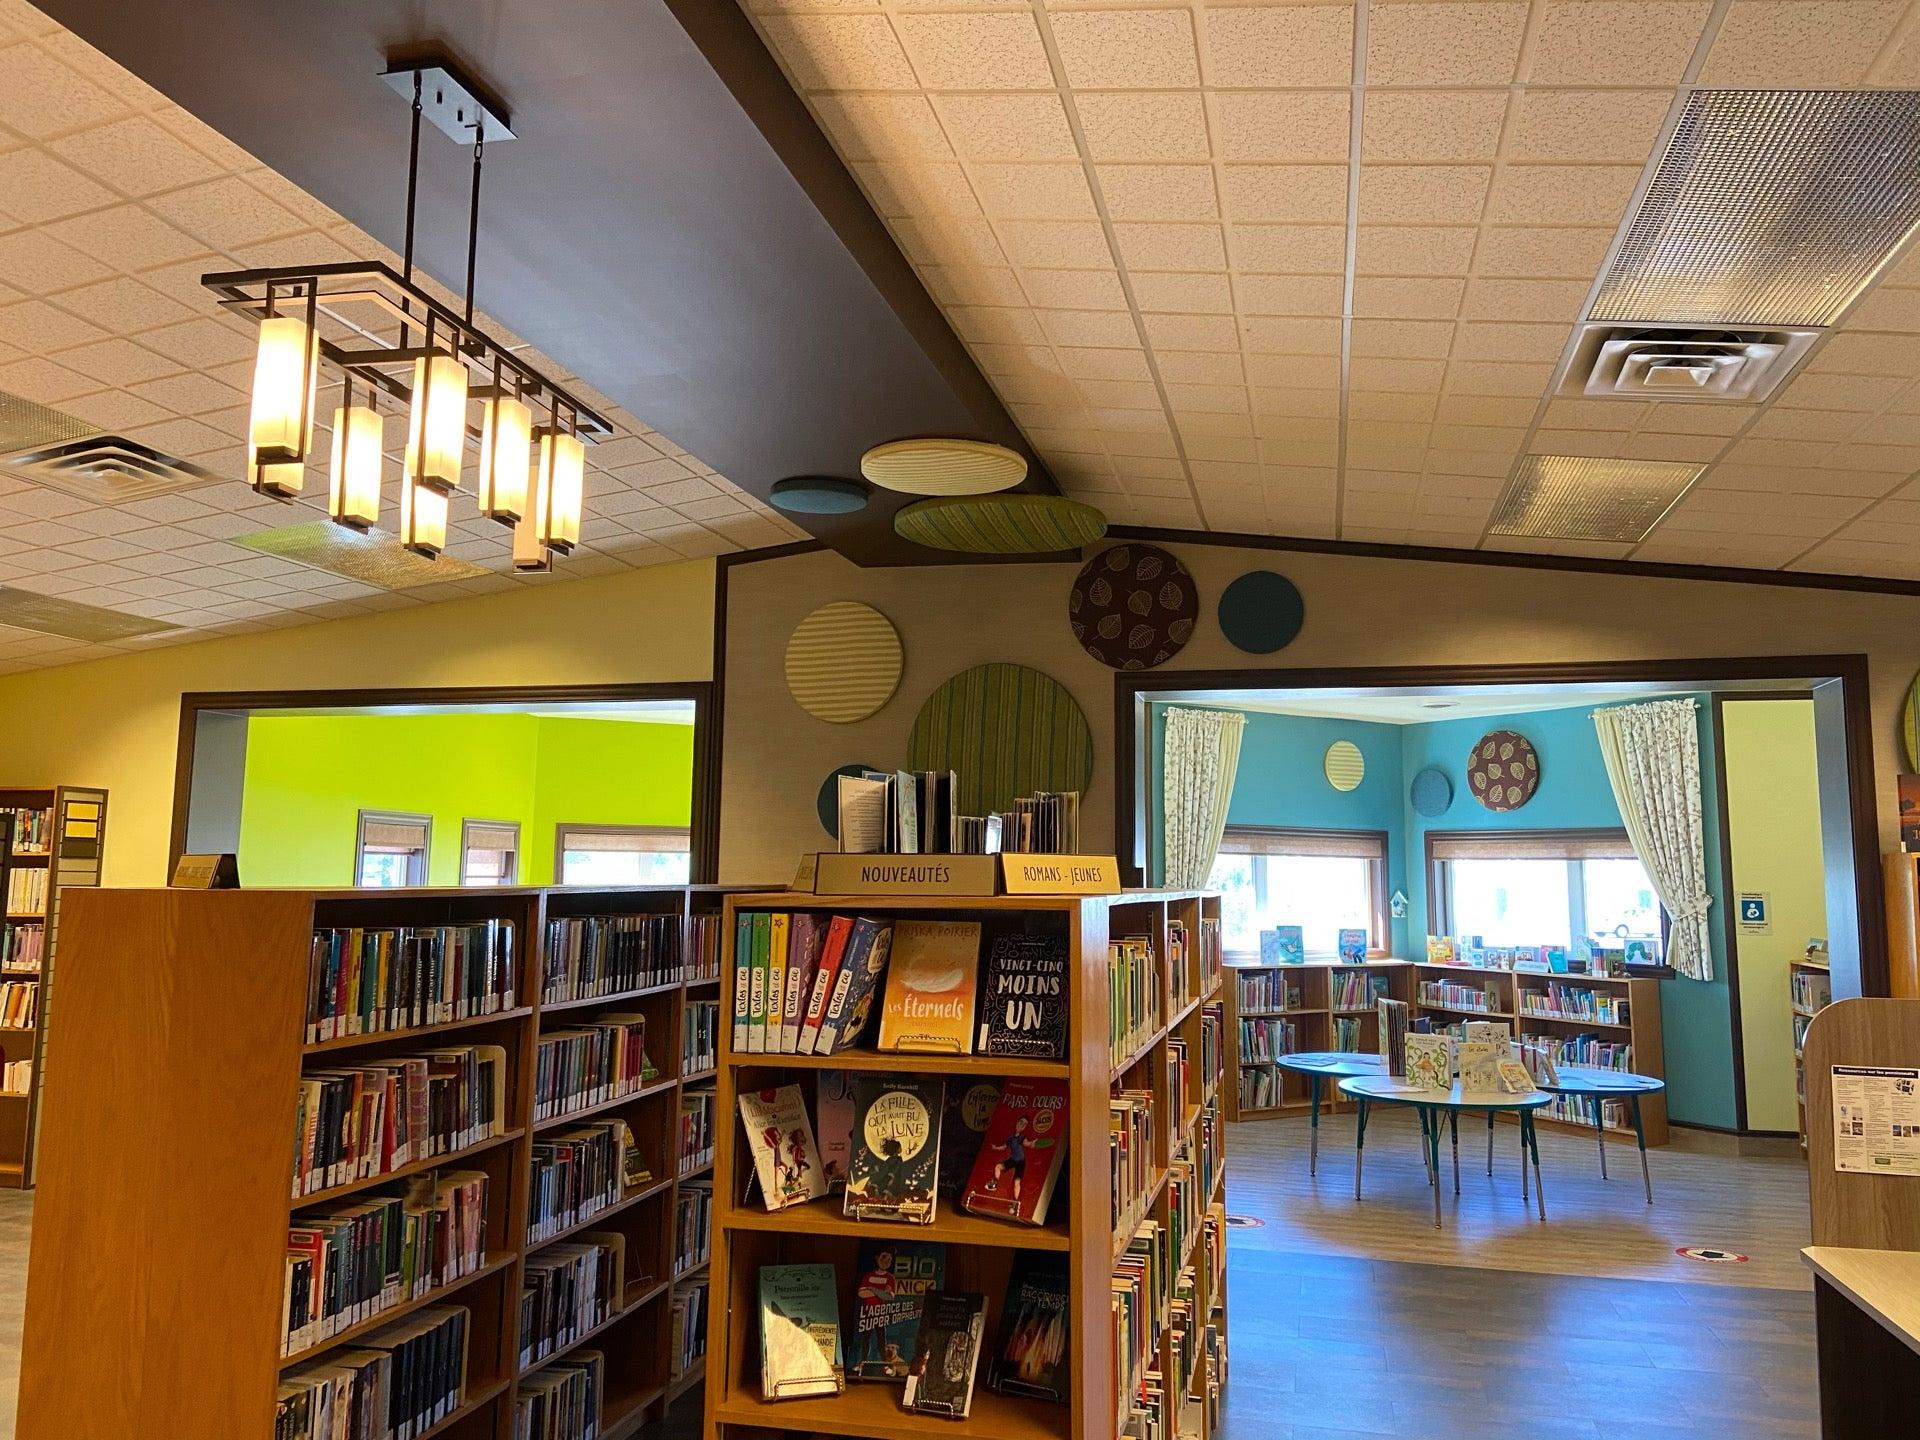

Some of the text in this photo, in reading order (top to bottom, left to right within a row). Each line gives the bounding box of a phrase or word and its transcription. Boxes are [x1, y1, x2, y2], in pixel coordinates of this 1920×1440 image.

[861, 863, 950, 883] NOUVEAUTÉS
[1024, 866, 1061, 883] ROMANS
[1070, 867, 1103, 885] JEUNES
[1000, 958, 1063, 973] VINGT-CINQ
[997, 974, 1060, 995] MOINS
[903, 994, 964, 1020] Éternels
[1005, 1000, 1043, 1031] UN
[875, 1097, 915, 1114] LA FILLE
[868, 1113, 887, 1127] QUI
[906, 1111, 921, 1122] BU
[876, 1121, 924, 1138] LA LUNE
